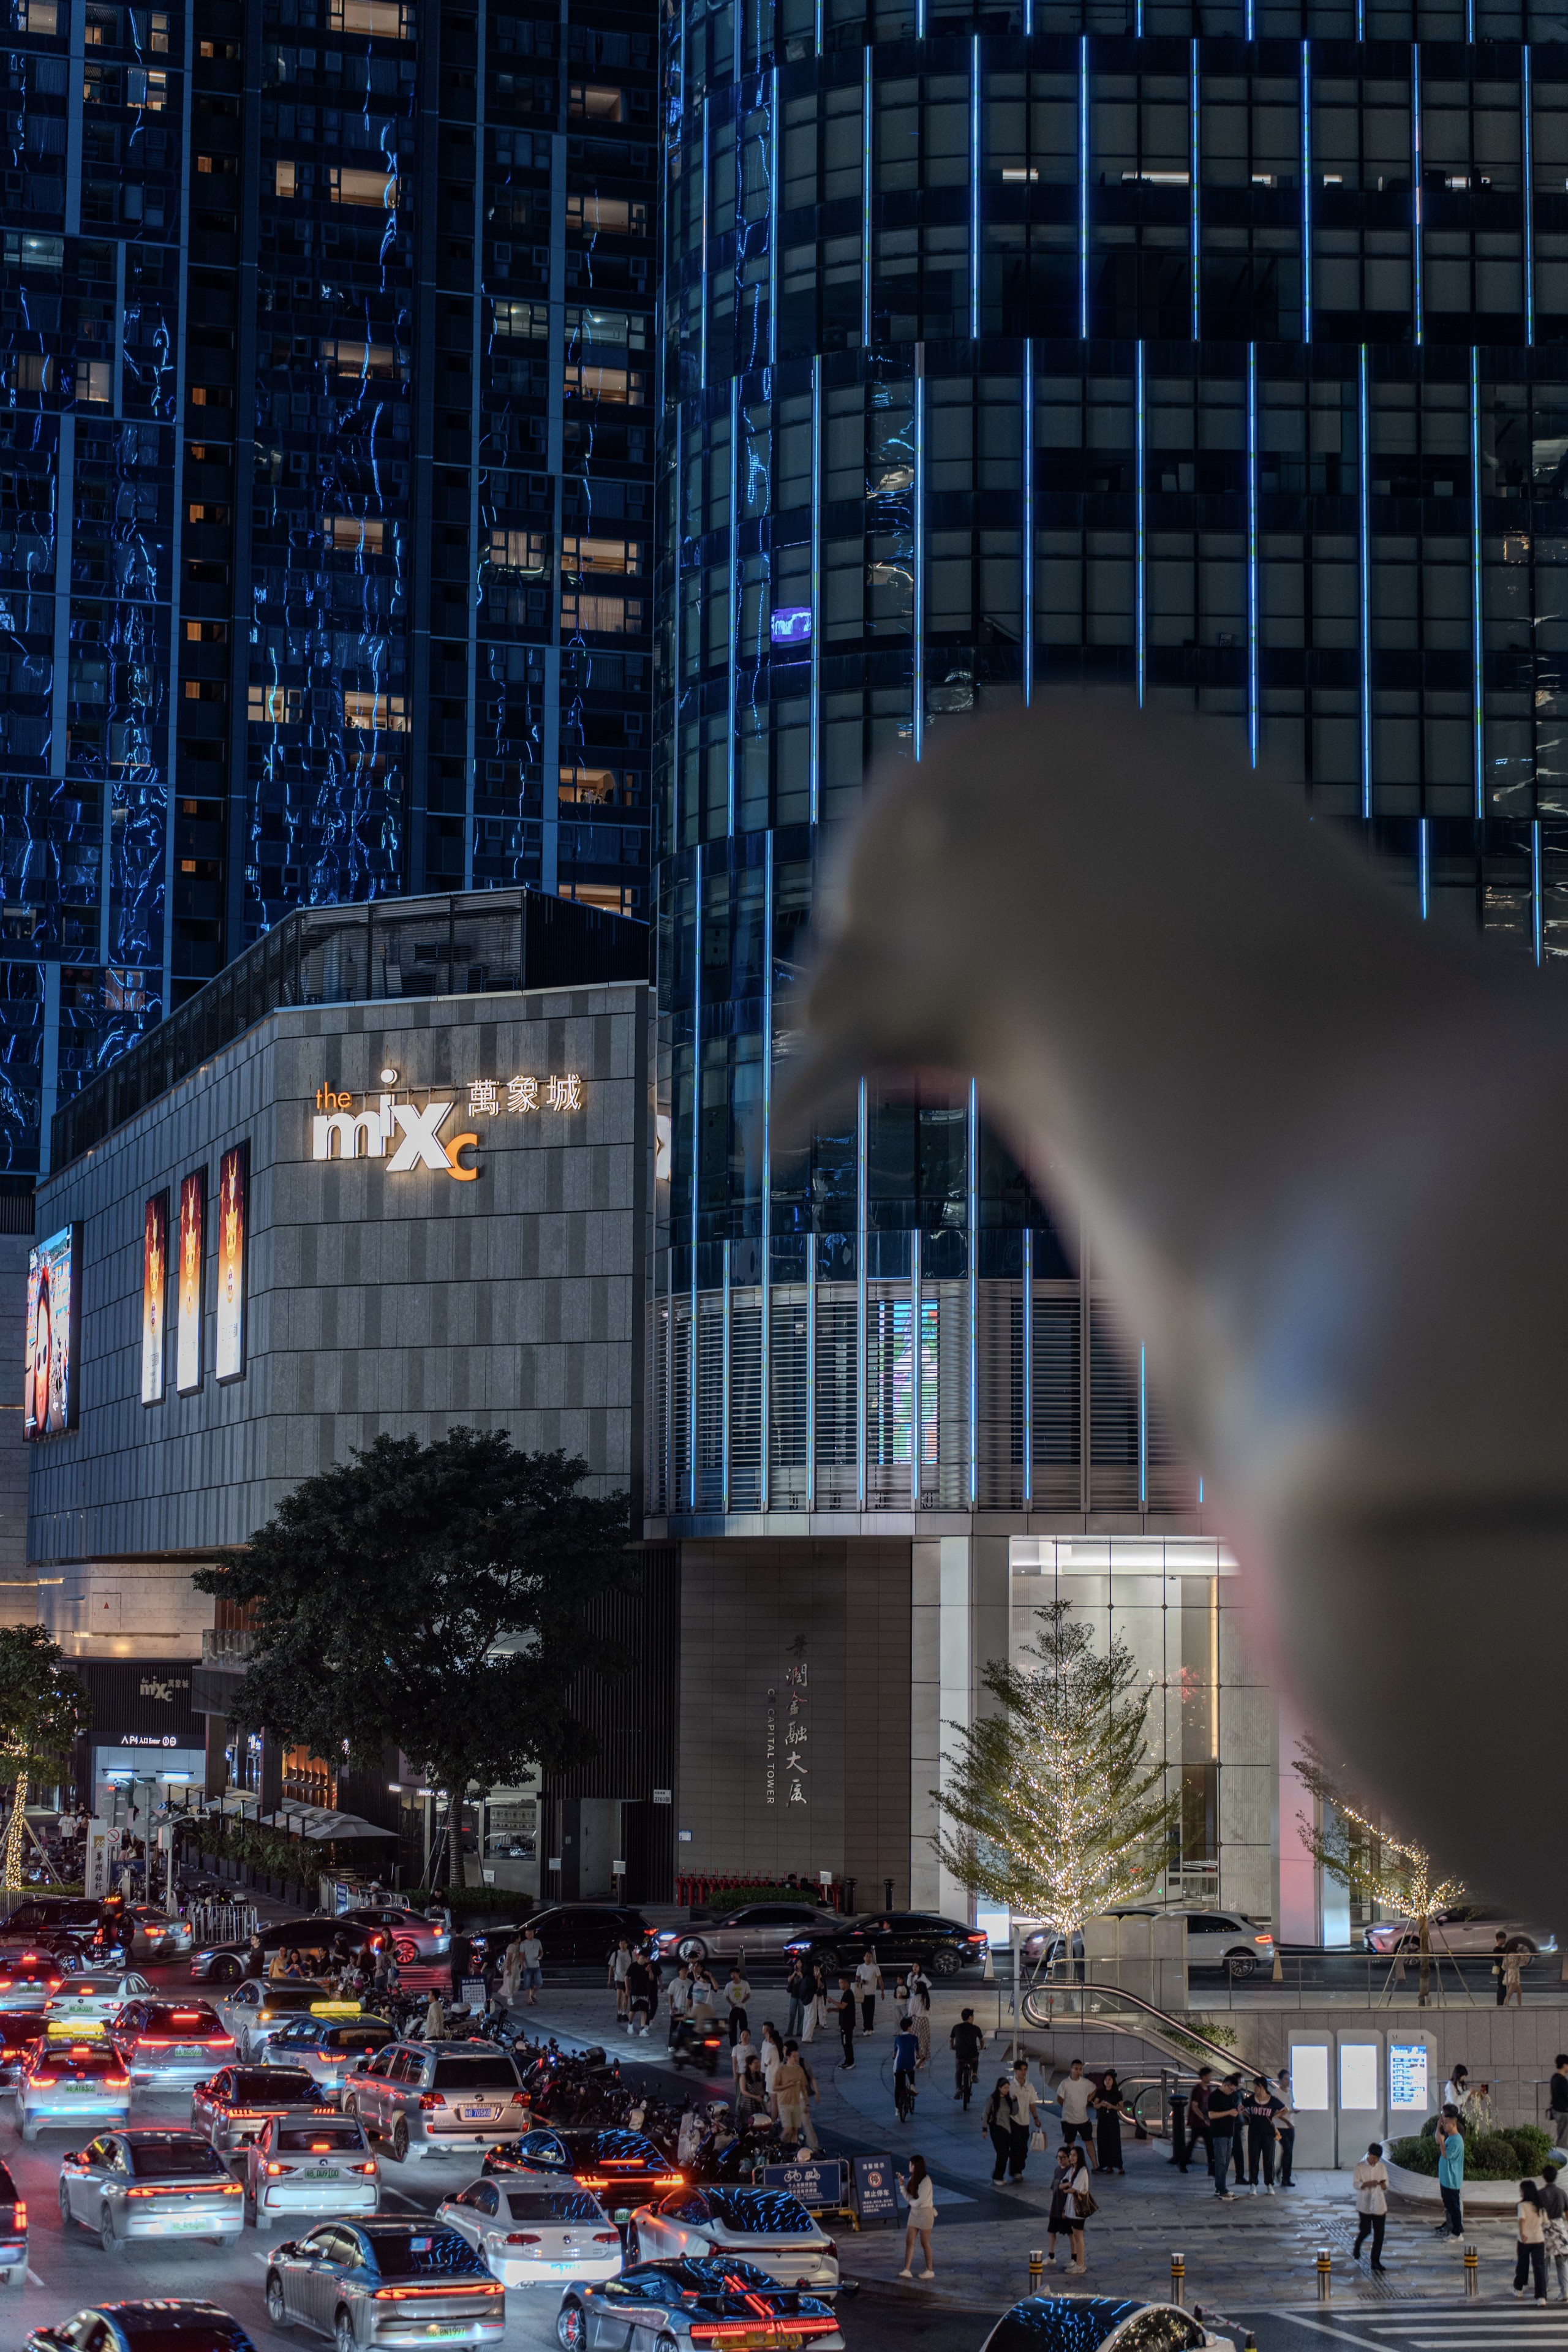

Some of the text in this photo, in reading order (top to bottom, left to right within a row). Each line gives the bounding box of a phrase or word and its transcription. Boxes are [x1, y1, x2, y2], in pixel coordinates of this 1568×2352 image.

[316, 1082, 352, 1109] the
[467, 1074, 582, 1117] 萬象城
[129, 1735, 138, 1744] P4
[767, 1708, 775, 1758] CAPITAL
[767, 1763, 775, 1804] TOWER
[864, 2189, 889, 2198] 禁止停车
[440, 2327, 464, 2336] BN1997
[774, 2334, 799, 2343] TAXI
